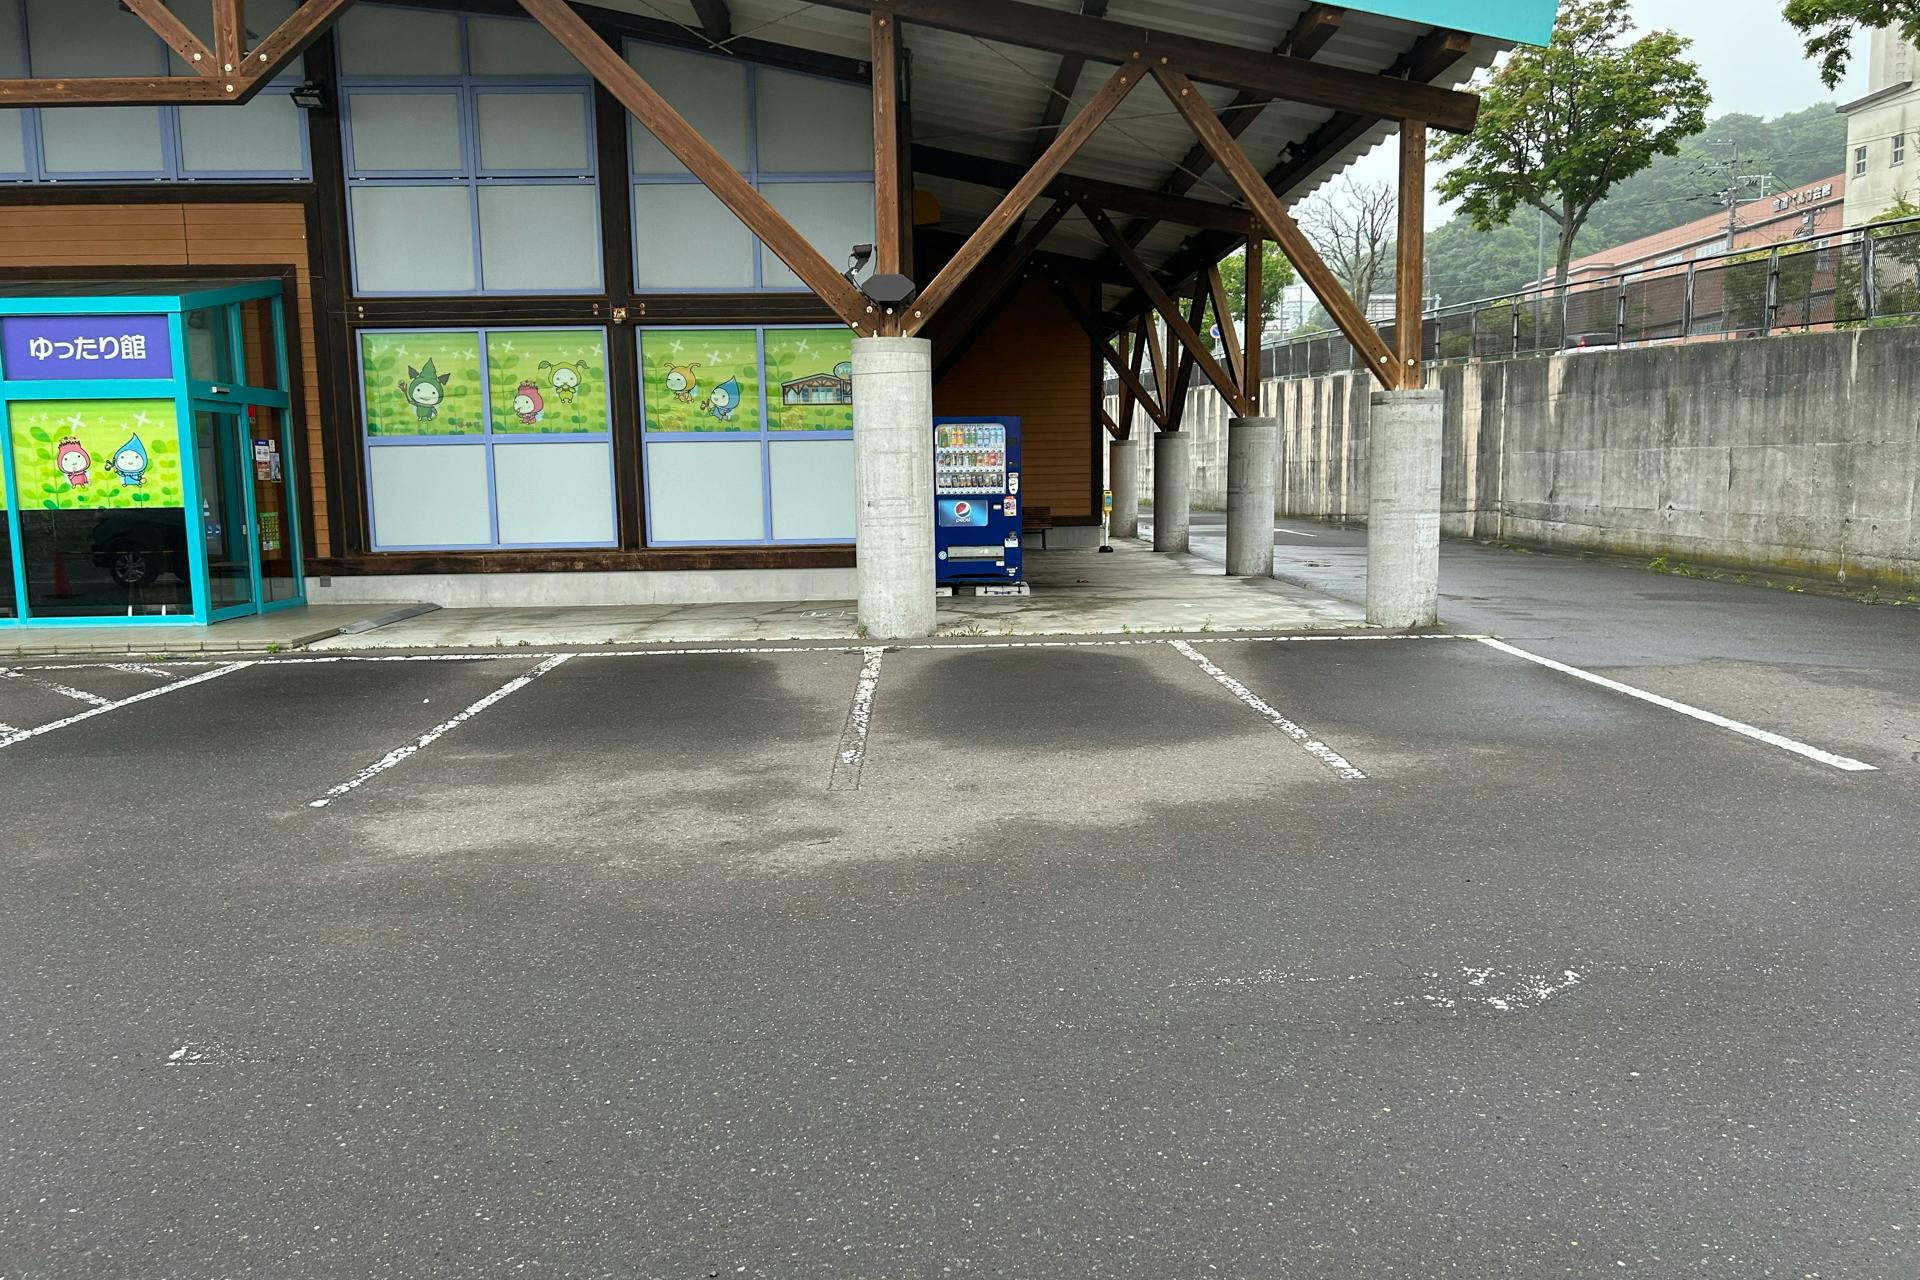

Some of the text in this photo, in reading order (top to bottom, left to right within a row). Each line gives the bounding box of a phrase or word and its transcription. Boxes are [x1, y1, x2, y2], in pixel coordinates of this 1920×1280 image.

[29, 335, 146, 360] ゆったり館
